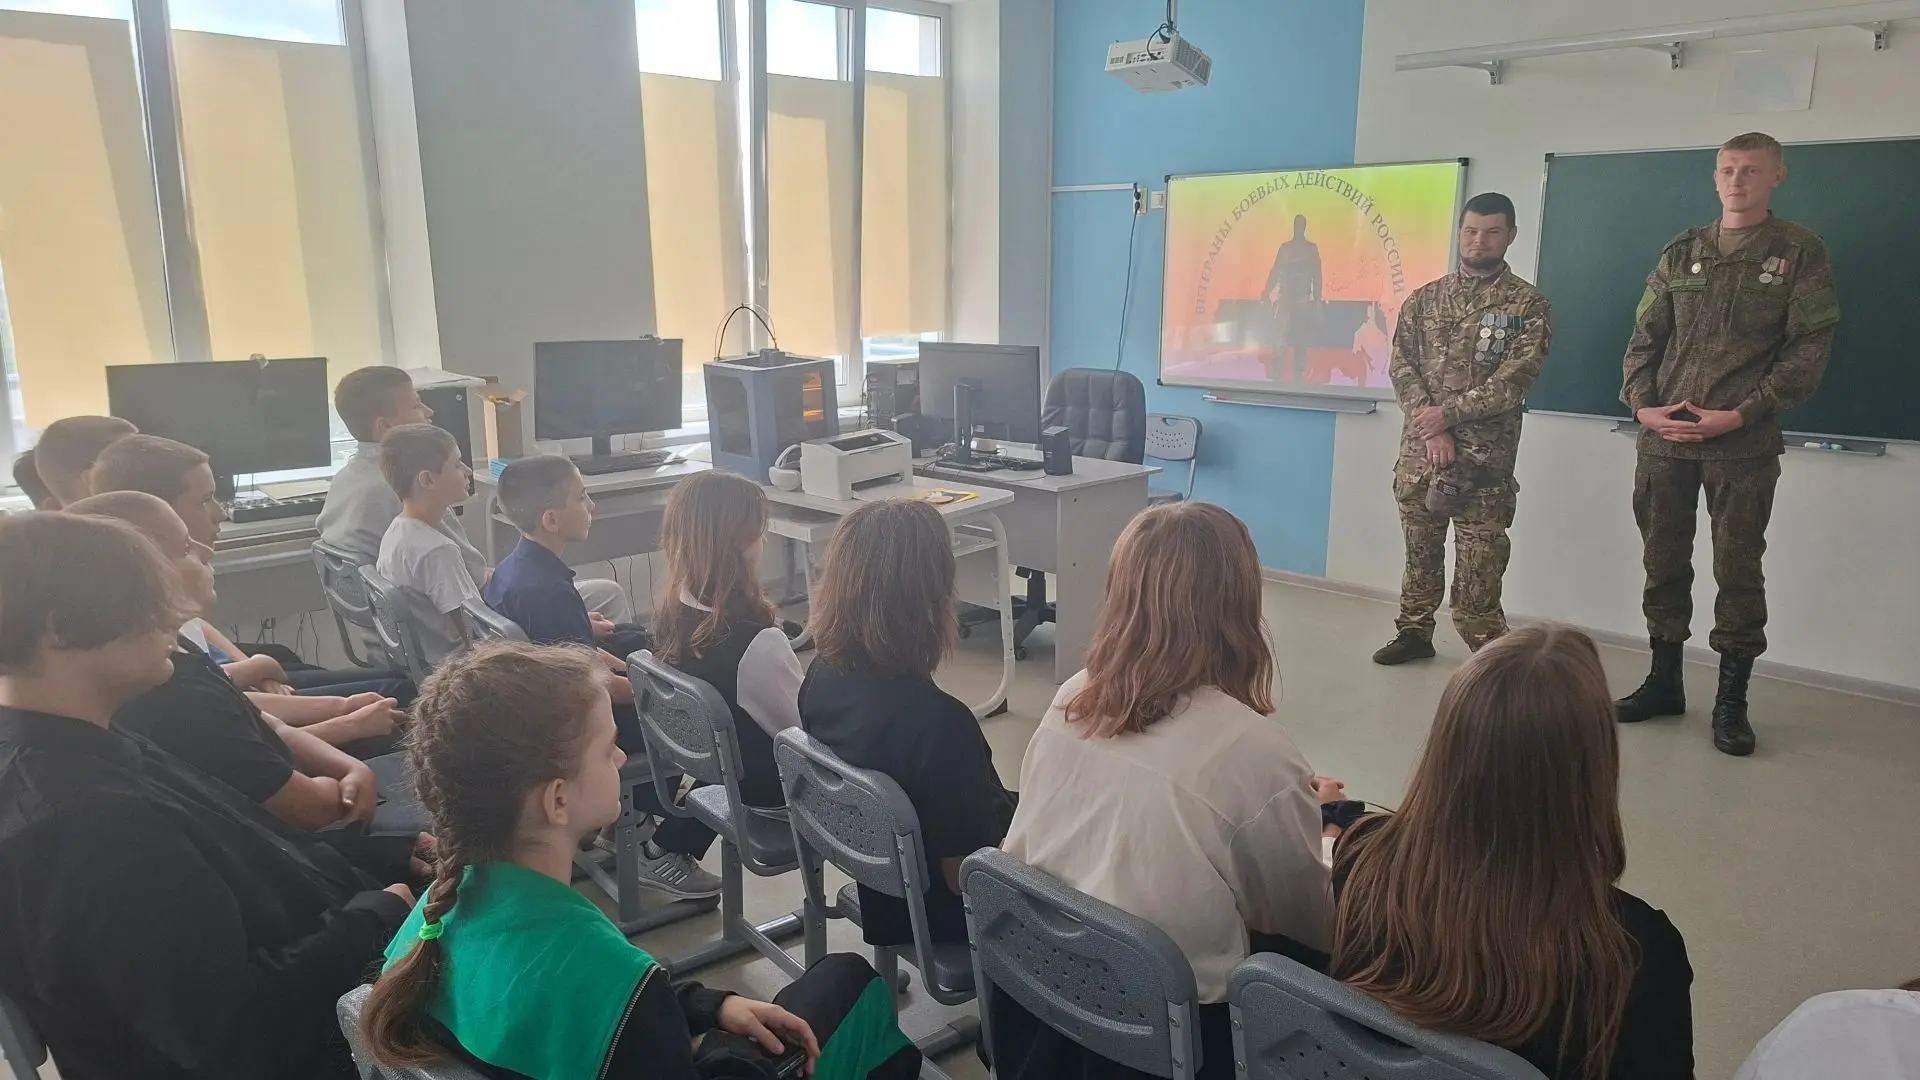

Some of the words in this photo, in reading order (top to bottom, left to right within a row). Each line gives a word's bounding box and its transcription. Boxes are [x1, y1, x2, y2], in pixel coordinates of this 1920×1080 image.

[1232, 175, 1290, 221] БОЕВЫХ
[1295, 169, 1374, 216] ДЕЙСТВИЙ
[1371, 213, 1405, 294] РОССИИ
